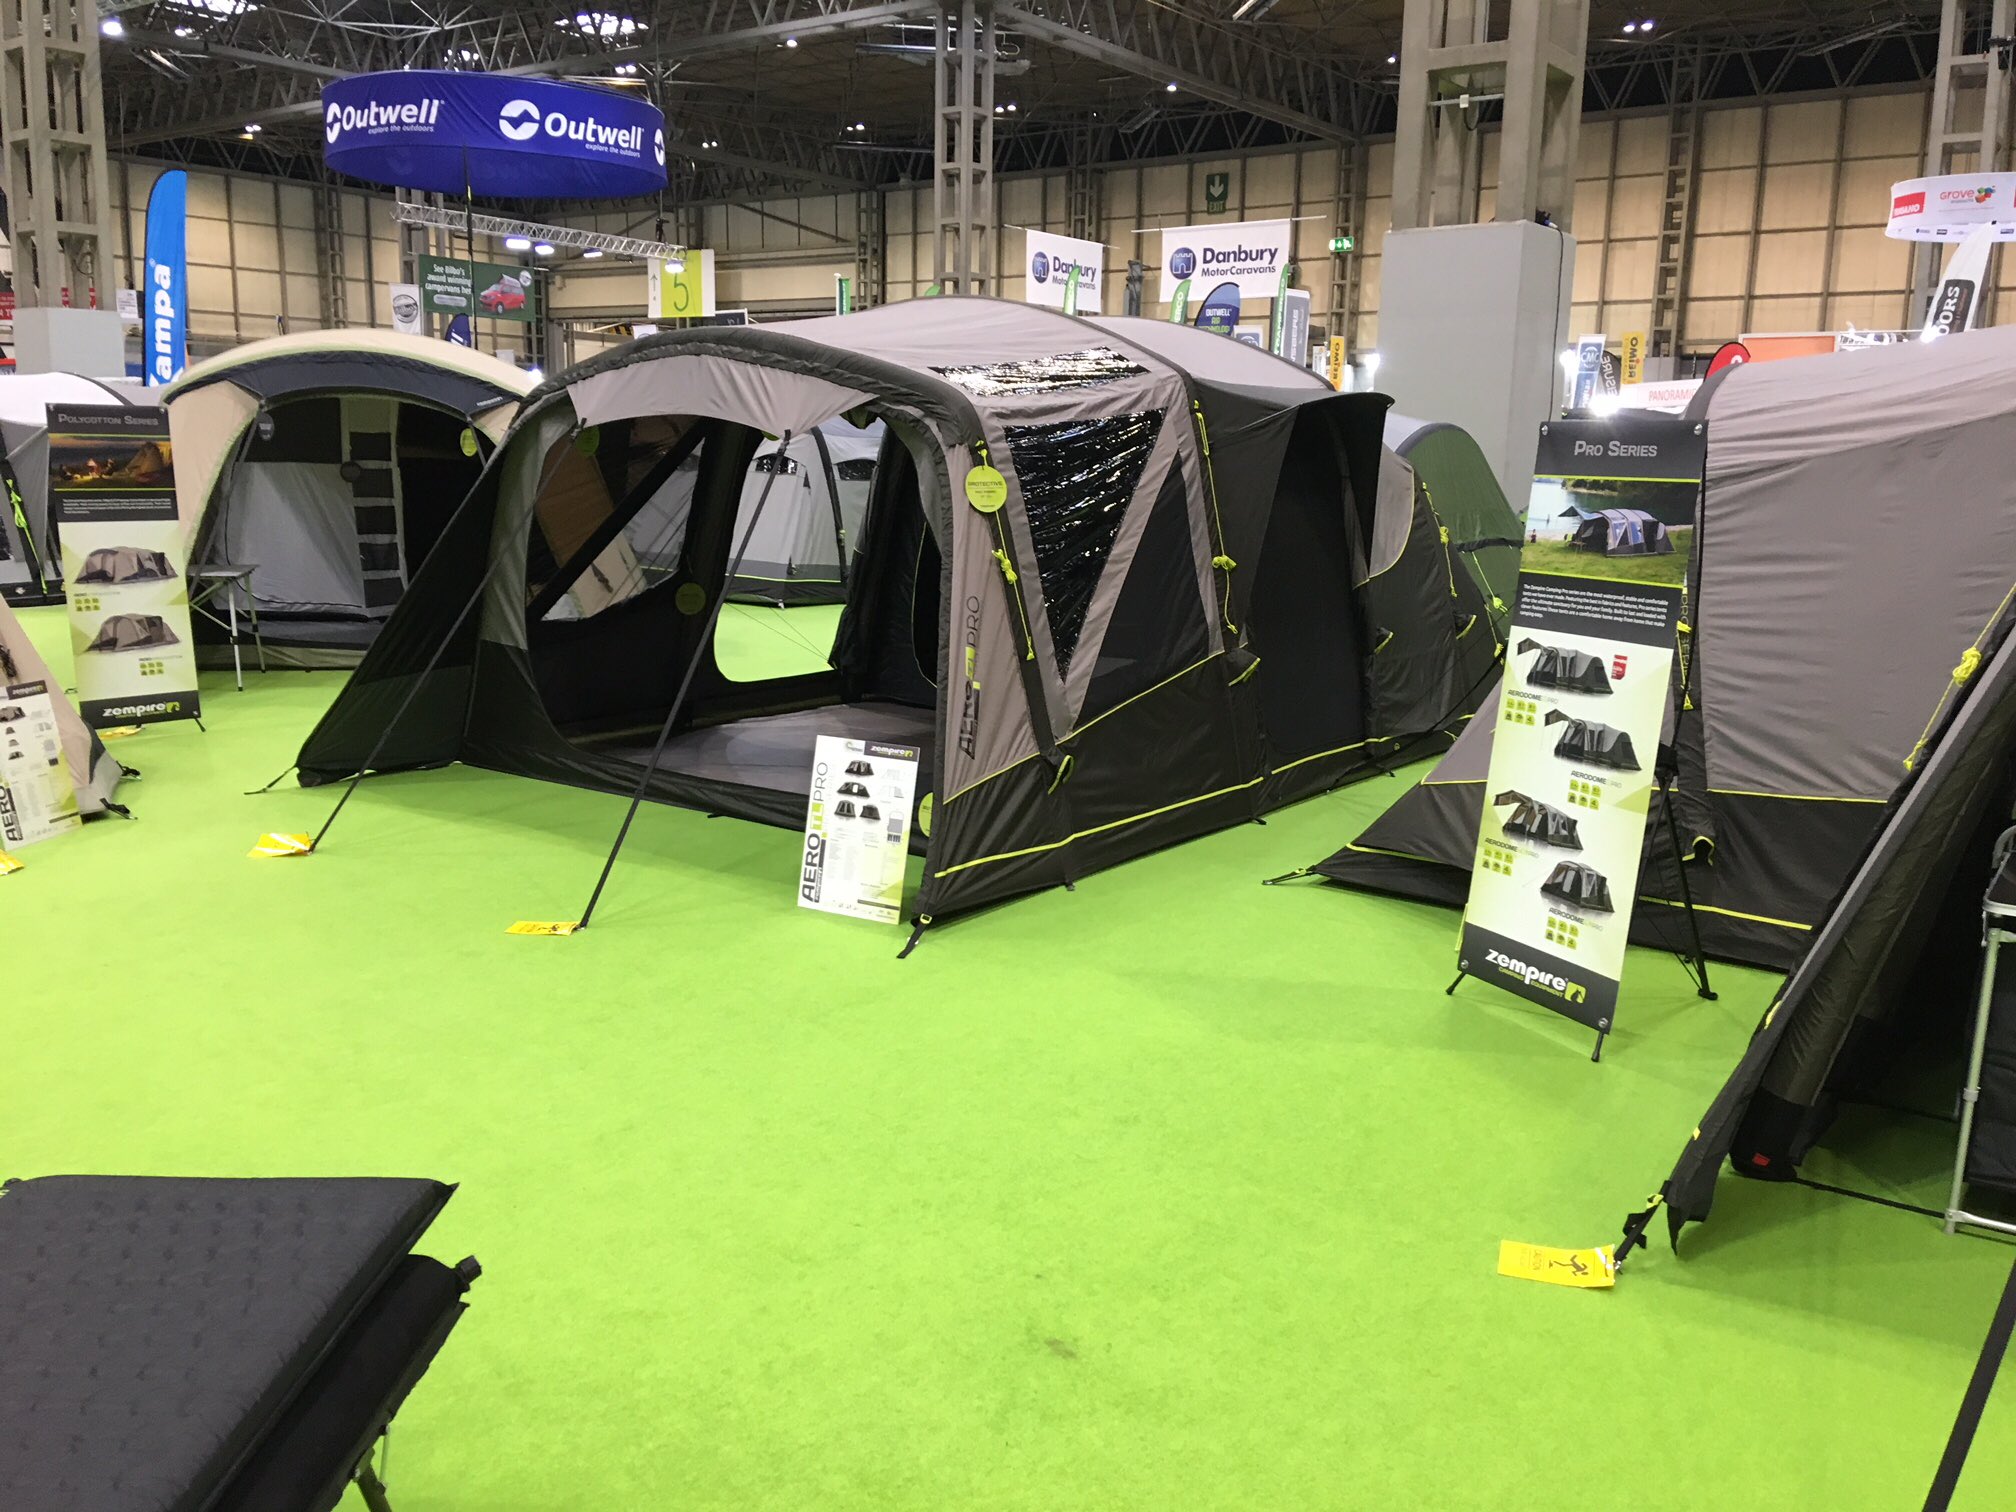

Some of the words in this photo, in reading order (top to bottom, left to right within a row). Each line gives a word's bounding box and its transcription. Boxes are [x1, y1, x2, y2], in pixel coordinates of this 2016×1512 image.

[342, 99, 440, 131] Outwell
[544, 112, 643, 150] Outwell
[1202, 244, 1278, 265] Danbury
[433, 264, 444, 272] See
[1201, 265, 1276, 278] MotorCaravans
[674, 269, 689, 312] 5
[58, 414, 122, 424] POLYCOTTON
[124, 415, 159, 426] SERIES
[1574, 440, 1604, 456] PRO
[1607, 440, 1658, 458] SERIES
[966, 596, 980, 647] PRO
[1507, 688, 1542, 702] AERODOME
[1570, 770, 1607, 785] AERODOME
[802, 833, 821, 903] AERO
[813, 762, 829, 802] PRO
[1484, 837, 1518, 852] AERODOME
[1548, 907, 1585, 925] AERODOME
[1484, 948, 1567, 991] zempire
